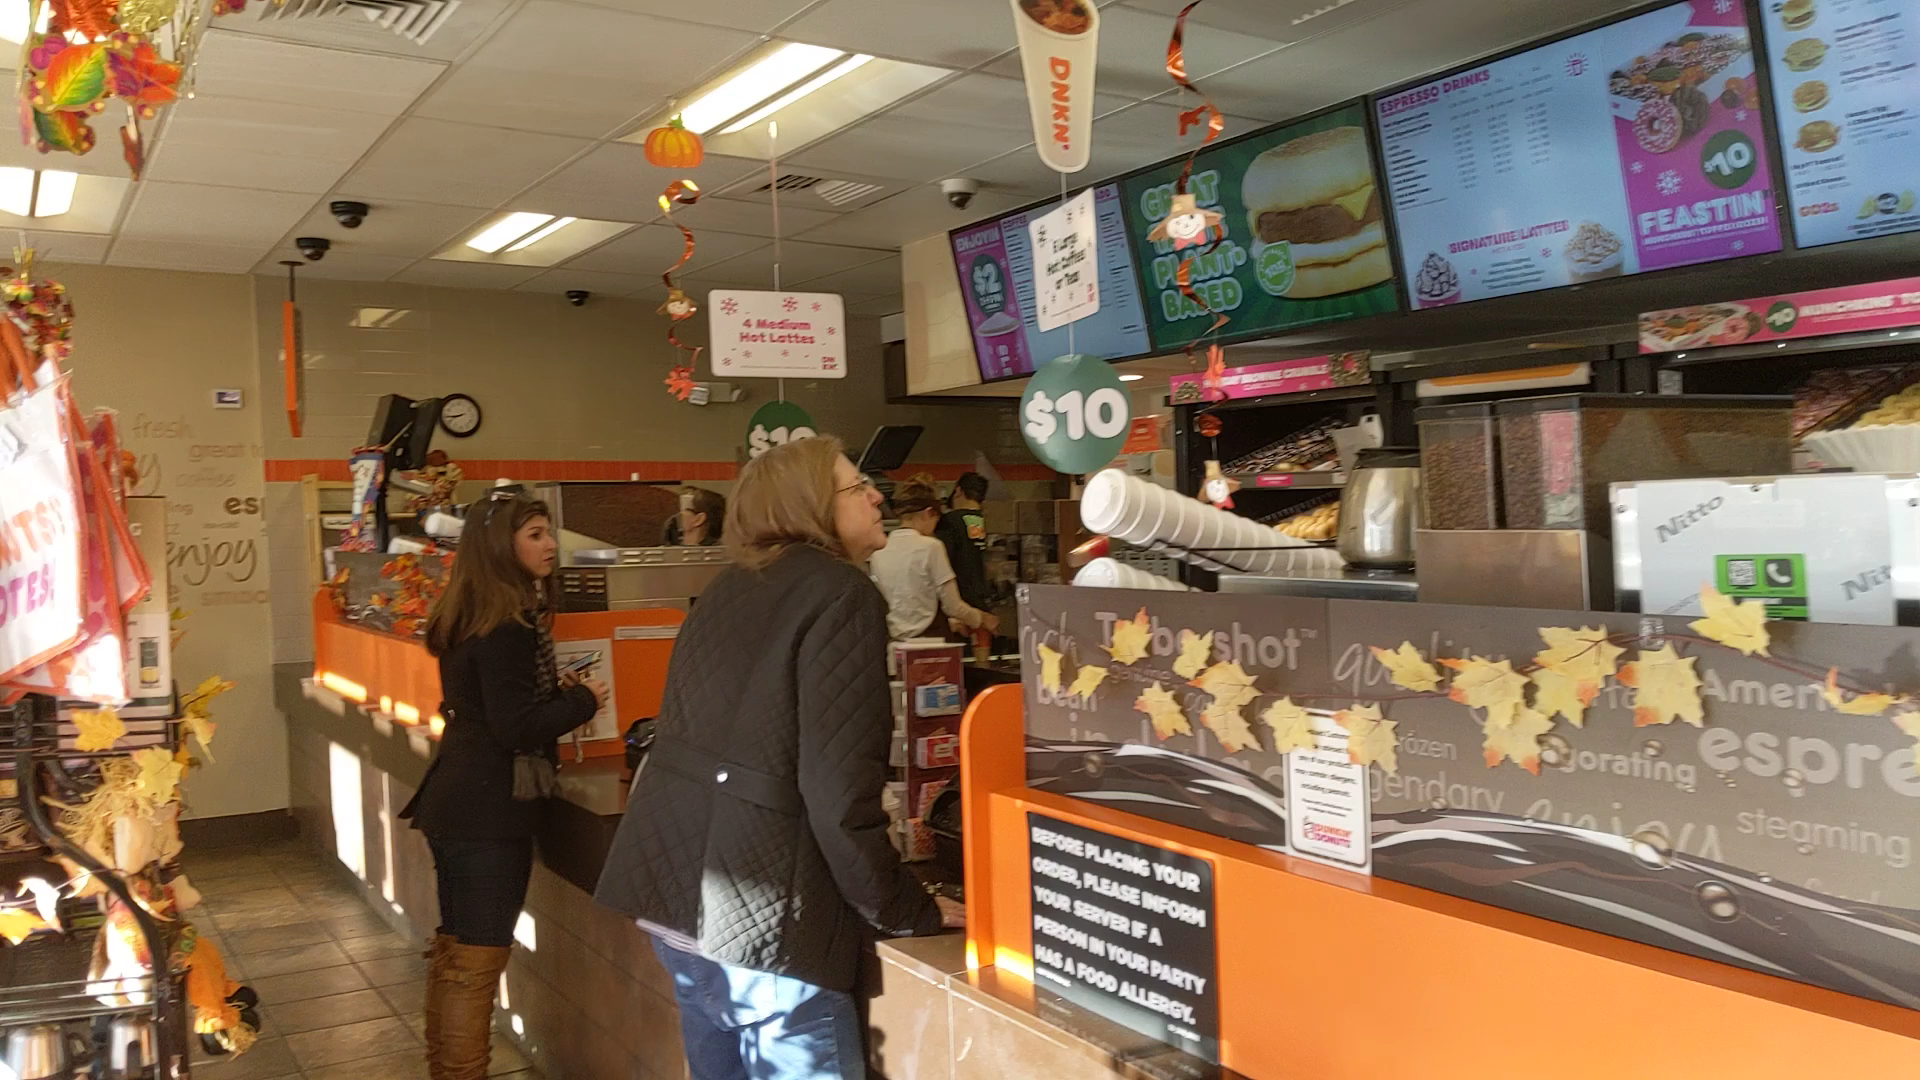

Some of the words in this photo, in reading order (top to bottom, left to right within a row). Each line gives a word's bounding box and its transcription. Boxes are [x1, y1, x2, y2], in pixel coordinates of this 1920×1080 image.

[1379, 85, 1440, 114] ESPRESSO
[1442, 69, 1491, 94] DRINKS
[1704, 142, 1751, 177] $10
[972, 262, 1003, 296] $2
[739, 332, 767, 343] Hot
[769, 333, 816, 344] Lattes
[742, 318, 752, 329] 4
[755, 318, 812, 331] Medium
[132, 411, 198, 440] fresh
[1025, 387, 1129, 445] $10
[1655, 495, 1725, 543] Nitto
[1370, 770, 1505, 810] gendary
[1399, 736, 1458, 760] rozen
[1565, 749, 1697, 793] gorating
[1031, 826, 1085, 858] BEFORE
[1084, 842, 1151, 878] PLACING
[1152, 862, 1201, 893] YOUR
[1735, 808, 1912, 869] steaming
[1032, 856, 1083, 889] ORDER,
[1083, 872, 1141, 906] PLEASE
[1141, 891, 1207, 928] INFORM
[1033, 885, 1072, 913] YOUR
[1073, 899, 1131, 935] SERVER
[1131, 919, 1148, 939] IF
[1148, 927, 1164, 947] A
[1034, 914, 1089, 950] PERSON
[1088, 936, 1106, 957] IN
[1106, 942, 1150, 975] YOUR
[1150, 959, 1207, 995] PARTY
[1035, 944, 1063, 970] HAS
[1063, 957, 1076, 976] A
[1076, 962, 1118, 993] FOOD
[1118, 981, 1197, 1026] ALLERGY.
